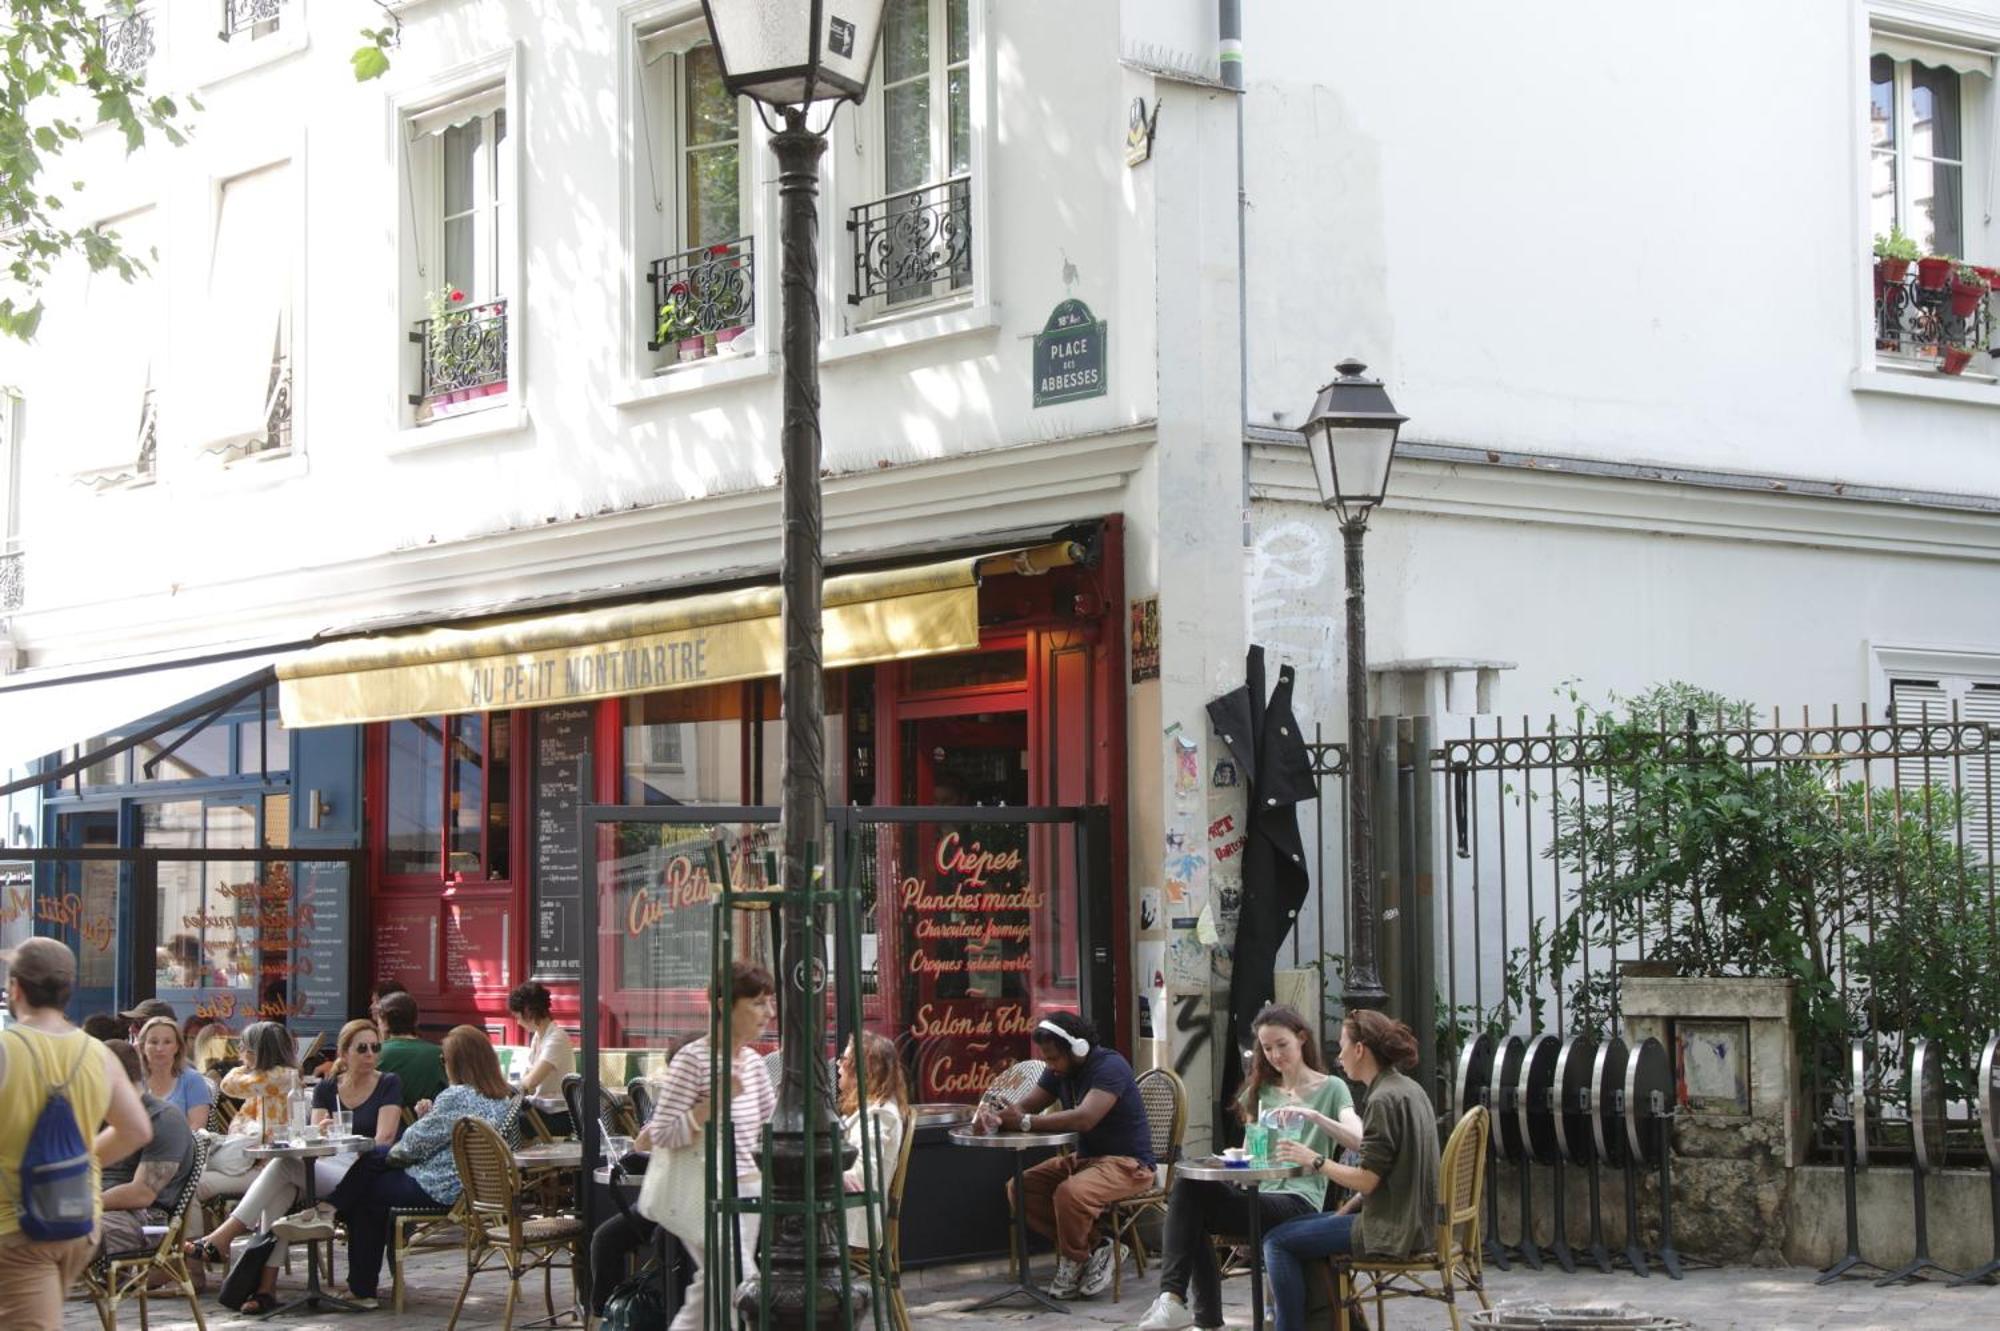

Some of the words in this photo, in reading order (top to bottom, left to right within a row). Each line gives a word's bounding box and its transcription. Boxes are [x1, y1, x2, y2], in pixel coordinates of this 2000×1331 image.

[1051, 339, 1088, 360] PLACE
[1041, 369, 1098, 392] ABBESSES
[472, 667, 494, 705] AU
[503, 659, 556, 702] PETIT
[566, 639, 707, 696] MONTMARTRE
[936, 832, 1022, 884] Crêpes
[902, 877, 981, 911] Planches
[911, 948, 963, 980] Croques
[911, 1003, 974, 1037] Salon
[976, 1011, 993, 1034] de
